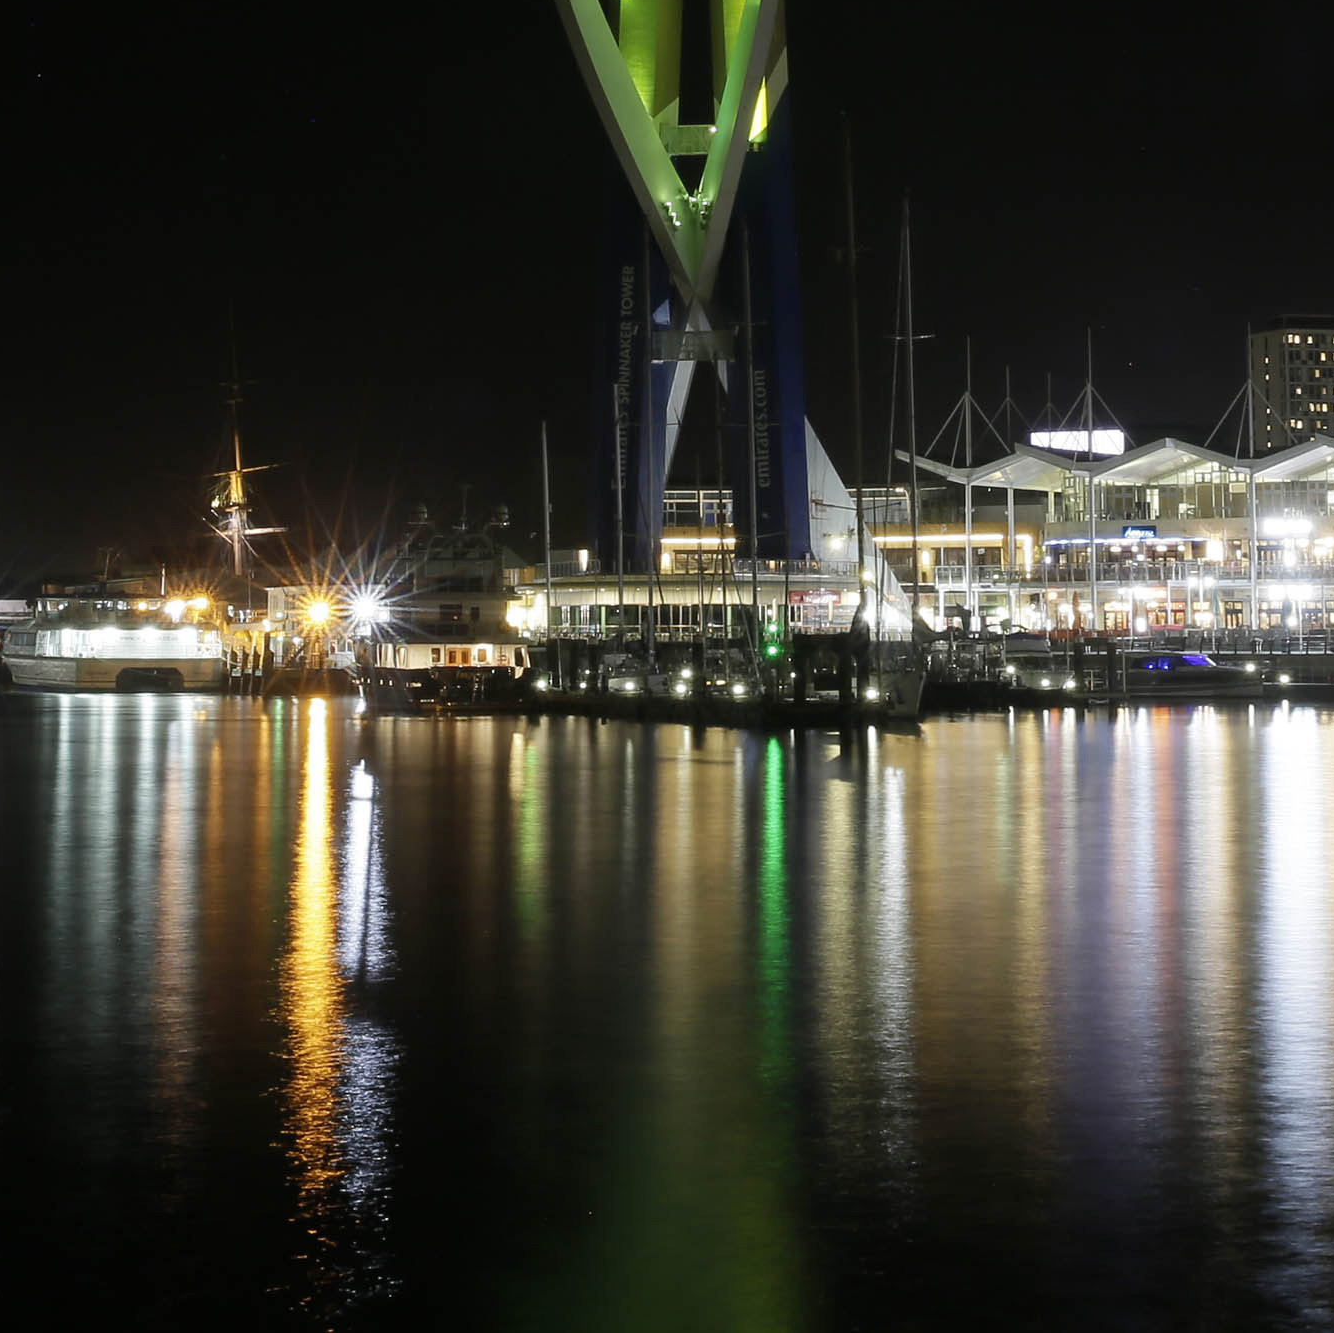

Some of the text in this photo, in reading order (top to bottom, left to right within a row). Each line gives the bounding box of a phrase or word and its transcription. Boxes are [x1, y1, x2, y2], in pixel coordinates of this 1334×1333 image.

[611, 266, 635, 490] Emirates SPINNAKER TOWER
[754, 370, 771, 488] emirates.com
